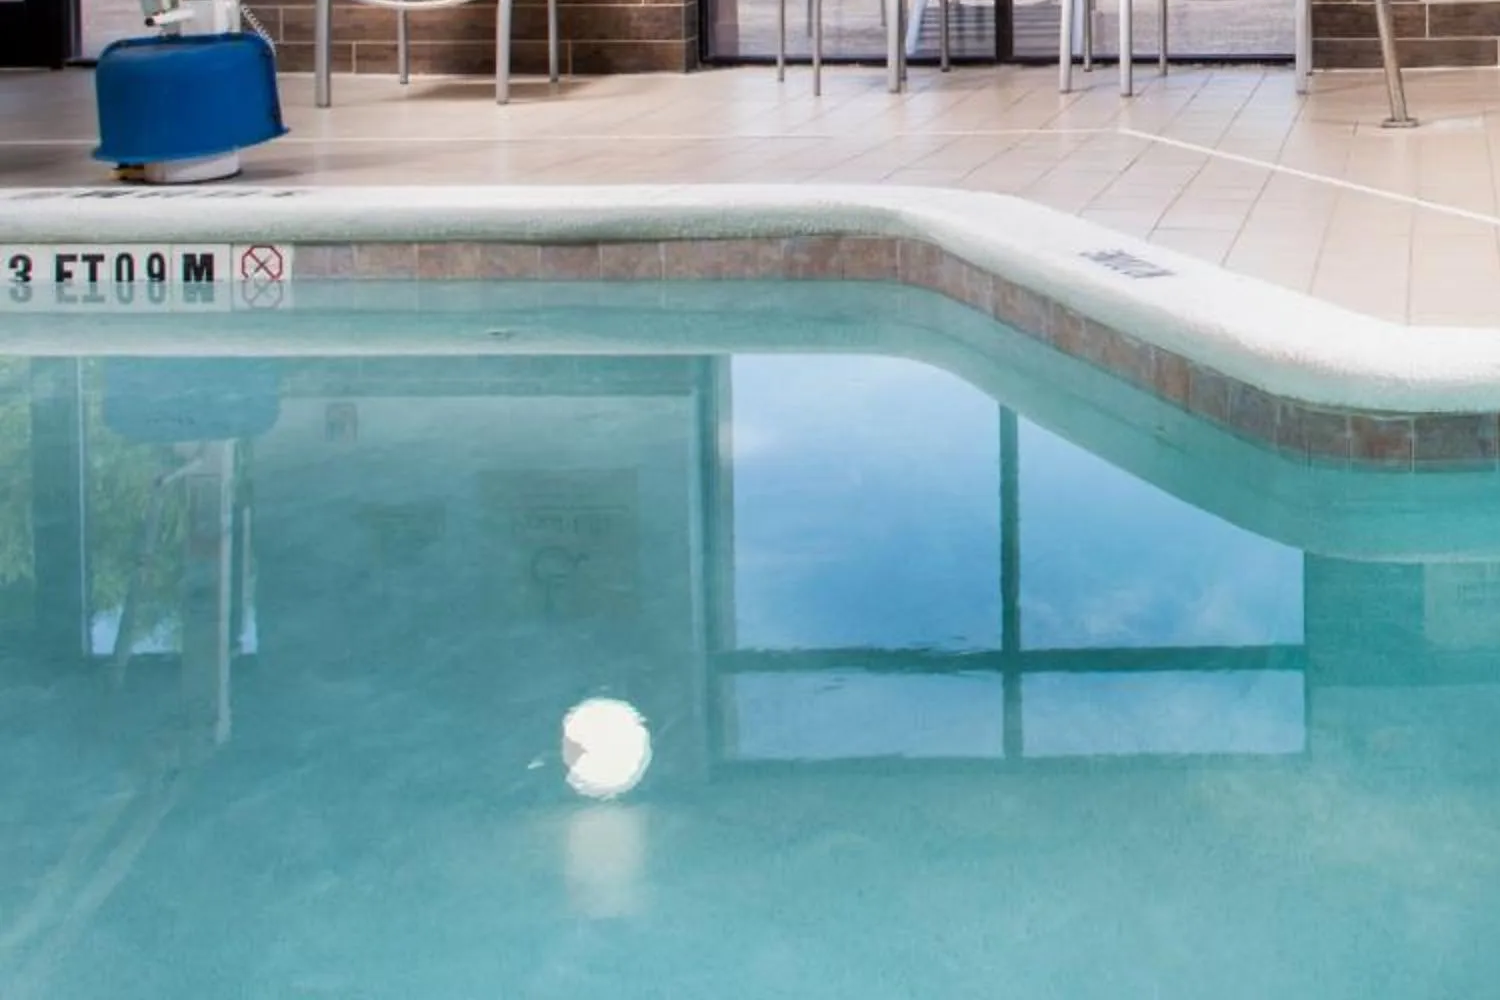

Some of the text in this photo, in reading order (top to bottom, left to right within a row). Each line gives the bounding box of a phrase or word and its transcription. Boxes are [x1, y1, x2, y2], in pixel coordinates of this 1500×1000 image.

[8, 253, 33, 283] 3
[55, 254, 105, 283] FT
[182, 254, 215, 283] M
